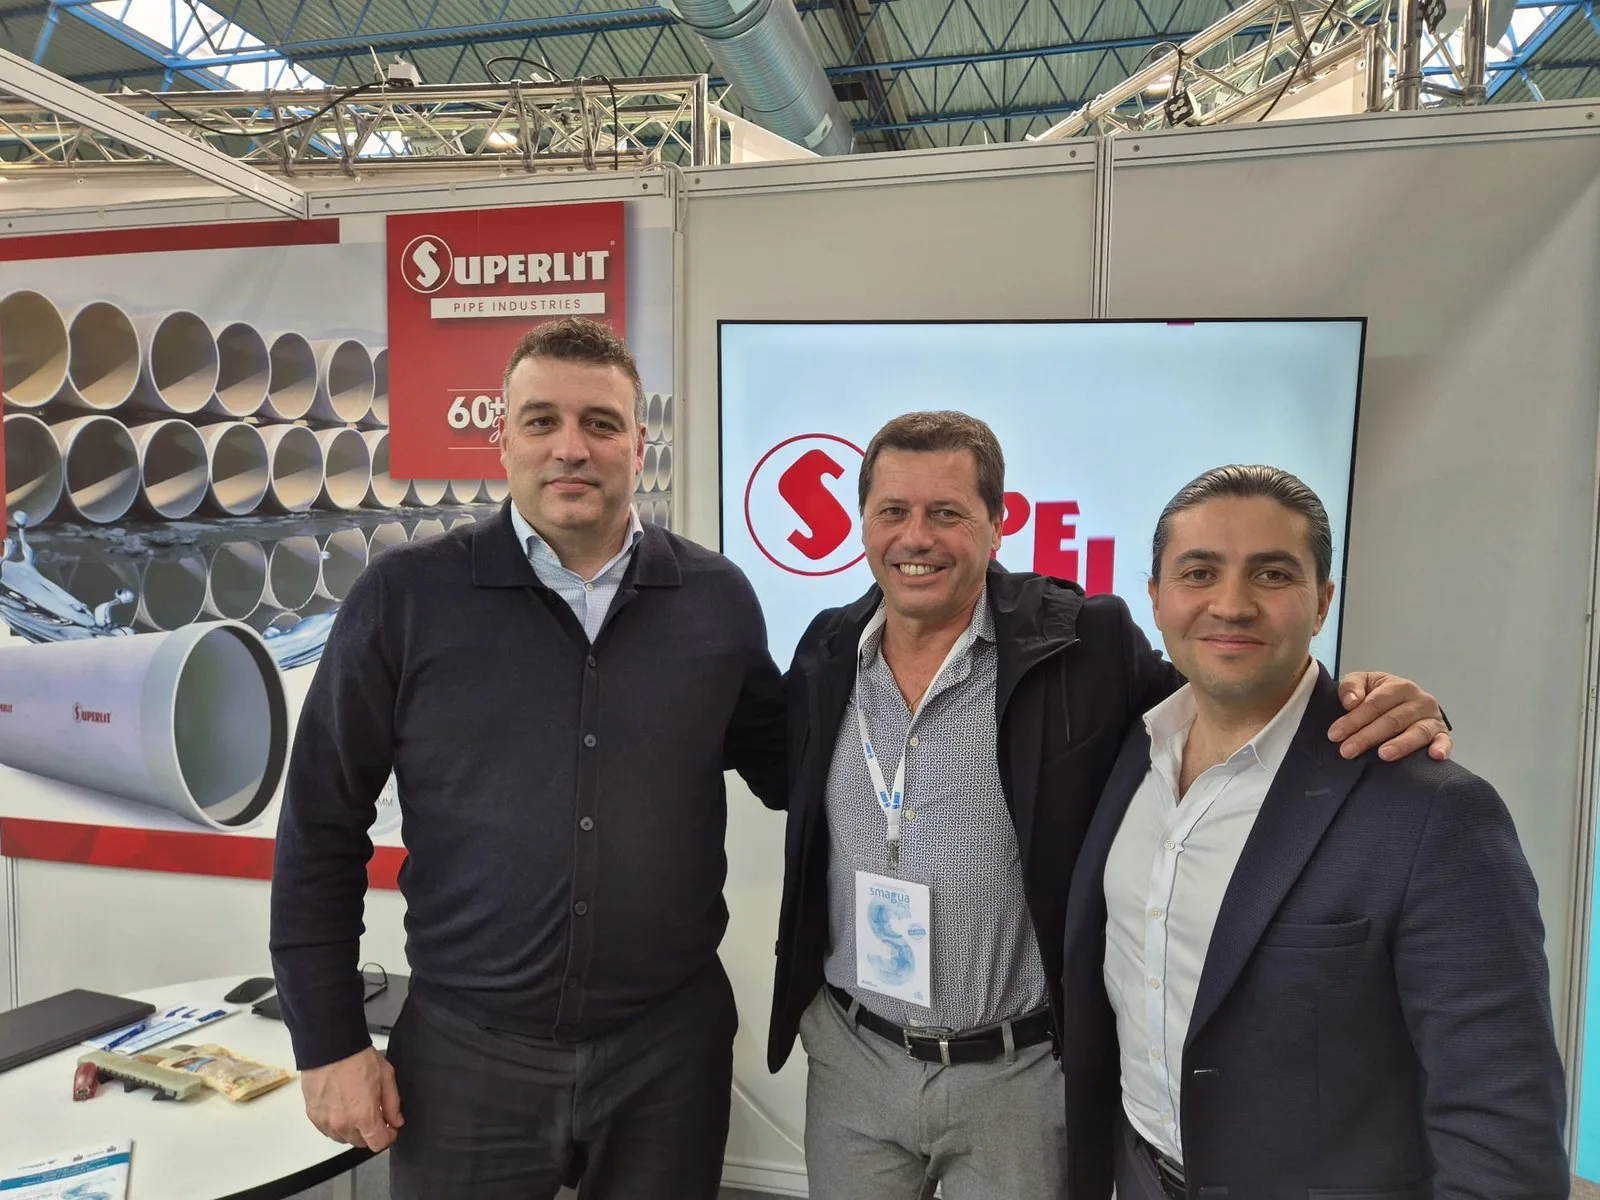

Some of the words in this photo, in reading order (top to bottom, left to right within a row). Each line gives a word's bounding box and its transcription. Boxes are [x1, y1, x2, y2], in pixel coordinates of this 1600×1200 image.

[411, 240, 609, 288] SUPERLIT
[453, 302, 485, 313] PIPE
[492, 299, 582, 312] INDUSTRIES
[869, 887, 911, 904] smagua
